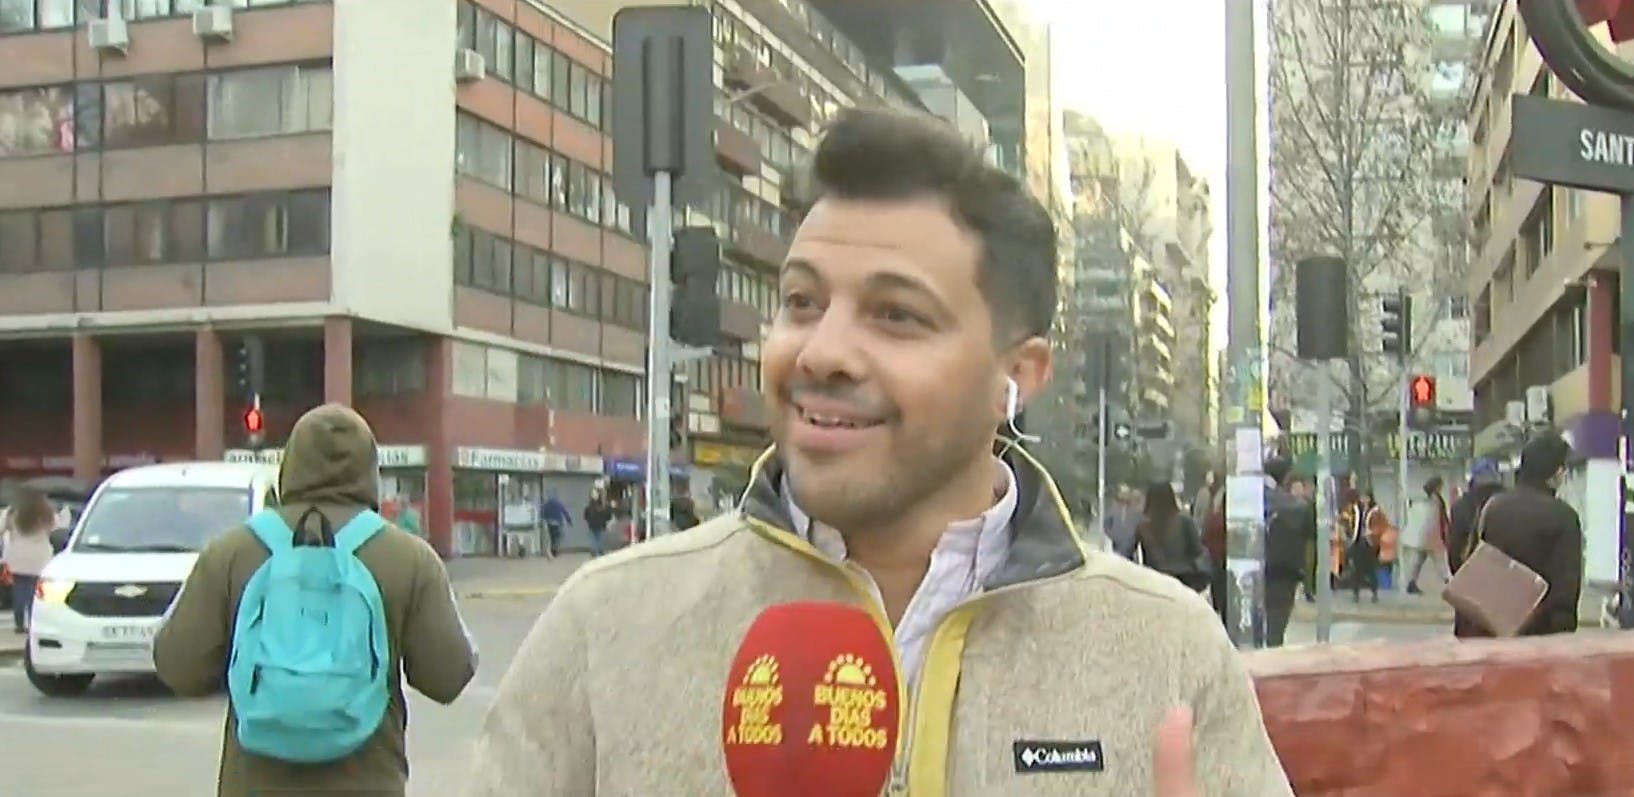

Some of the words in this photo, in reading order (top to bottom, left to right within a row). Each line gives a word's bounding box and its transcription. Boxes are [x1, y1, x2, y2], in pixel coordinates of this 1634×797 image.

[814, 684, 888, 711] BUENOS
[726, 724, 737, 744] A
[807, 723, 824, 745] A
[826, 725, 888, 749] TODOS
[1033, 747, 1097, 766] Columbia
